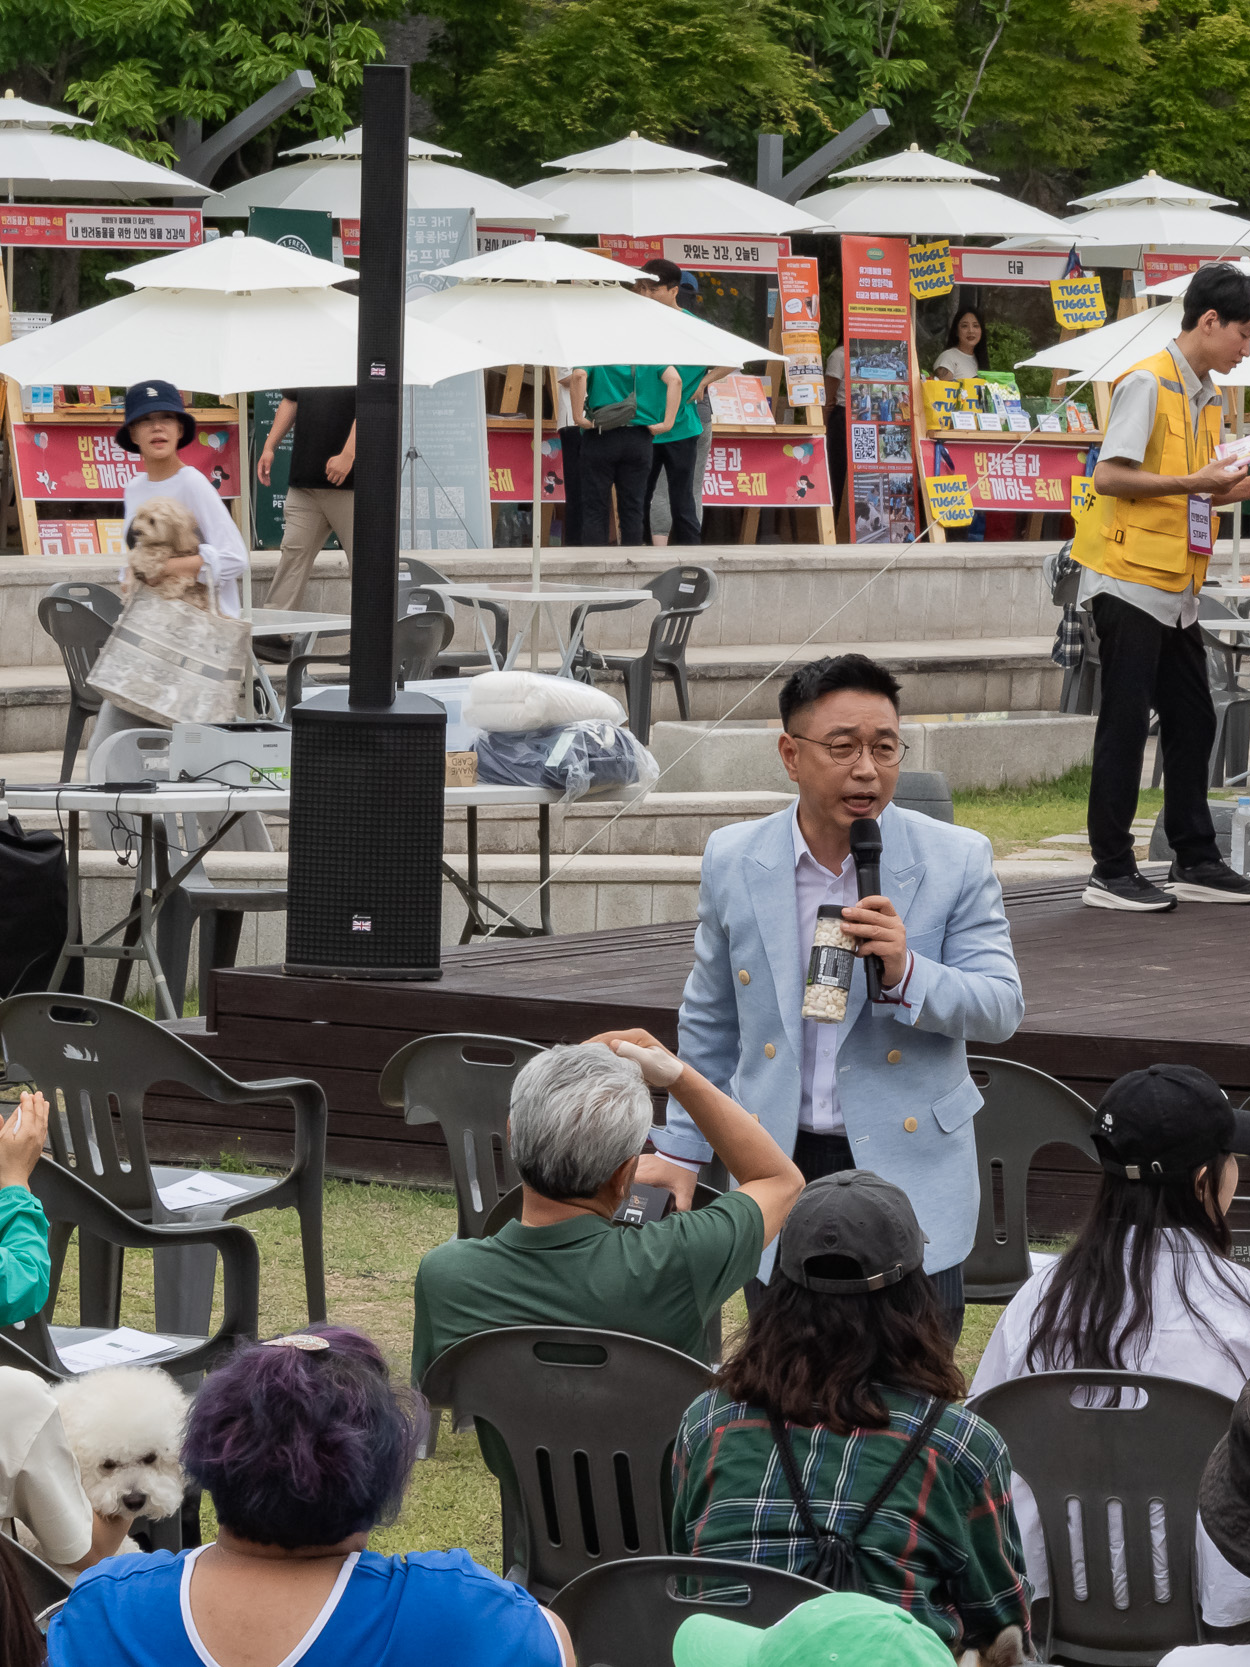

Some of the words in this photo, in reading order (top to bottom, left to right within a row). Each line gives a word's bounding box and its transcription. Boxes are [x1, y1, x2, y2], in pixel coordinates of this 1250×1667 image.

[81, 227, 115, 239] 반려동물을
[117, 227, 131, 240] 위한
[133, 228, 147, 240] 신선
[165, 229, 186, 240] 건강식
[683, 244, 710, 260] 맛있는
[712, 246, 733, 262] 건강,
[735, 246, 760, 262] 오늘틴
[909, 247, 951, 265] TUGGLE
[909, 262, 947, 280] TUGGLE
[914, 274, 956, 292] TUGGLE
[1058, 283, 1101, 297] TUGGLE
[1053, 297, 1097, 311] TUGGLE
[1063, 310, 1108, 324] TUGGLE
[974, 452, 1041, 477] 반려동물과
[736, 473, 768, 497] 축제
[933, 481, 969, 494] TUGGLE
[977, 476, 1034, 501] 함께하는
[1034, 478, 1065, 502] 축제
[930, 495, 966, 508] TUGGLE
[938, 508, 974, 521] TUGGLE
[1192, 529, 1208, 540] STAFF
[451, 757, 474, 766] CARD
[451, 767, 474, 776] NAME
